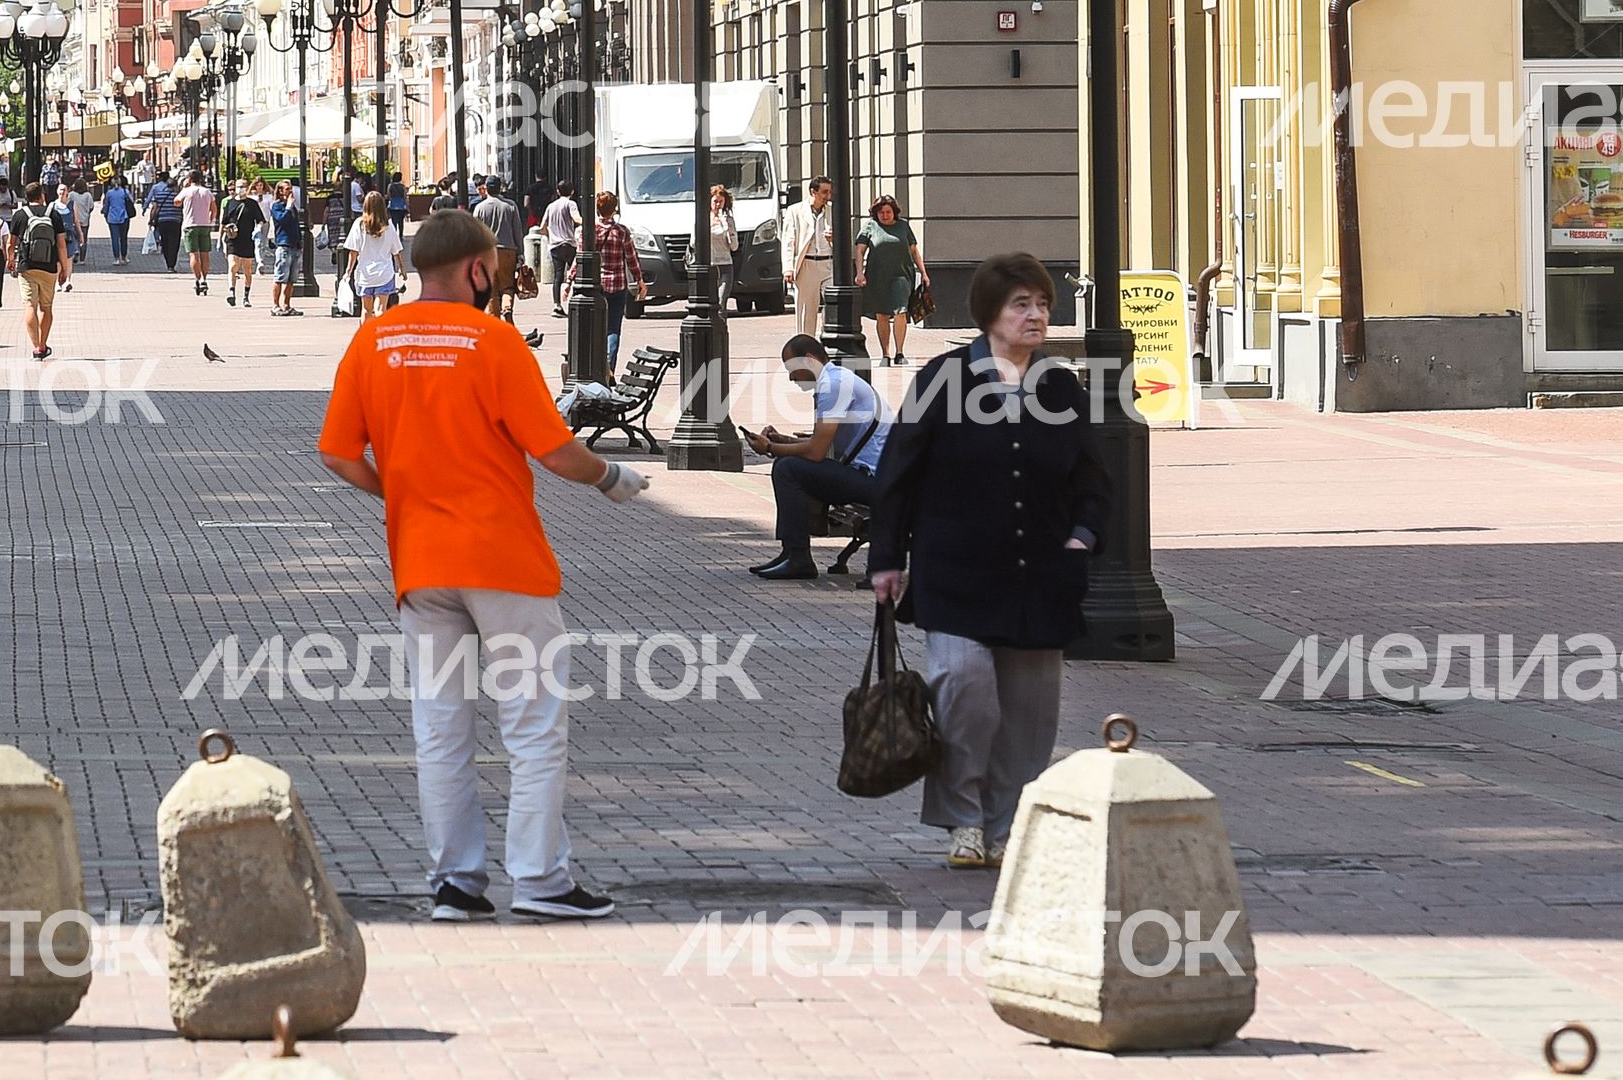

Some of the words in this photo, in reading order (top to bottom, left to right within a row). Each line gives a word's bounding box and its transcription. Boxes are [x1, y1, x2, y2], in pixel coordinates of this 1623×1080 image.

[1601, 143, 1616, 156] 49
[1569, 230, 1608, 240] HESBURGER
[1121, 286, 1175, 302] ATTOO
[1120, 319, 1178, 328] ТУИРОВКИ
[1133, 343, 1174, 353] АЛЕНИЕ
[1136, 357, 1160, 365] ТАТУ
